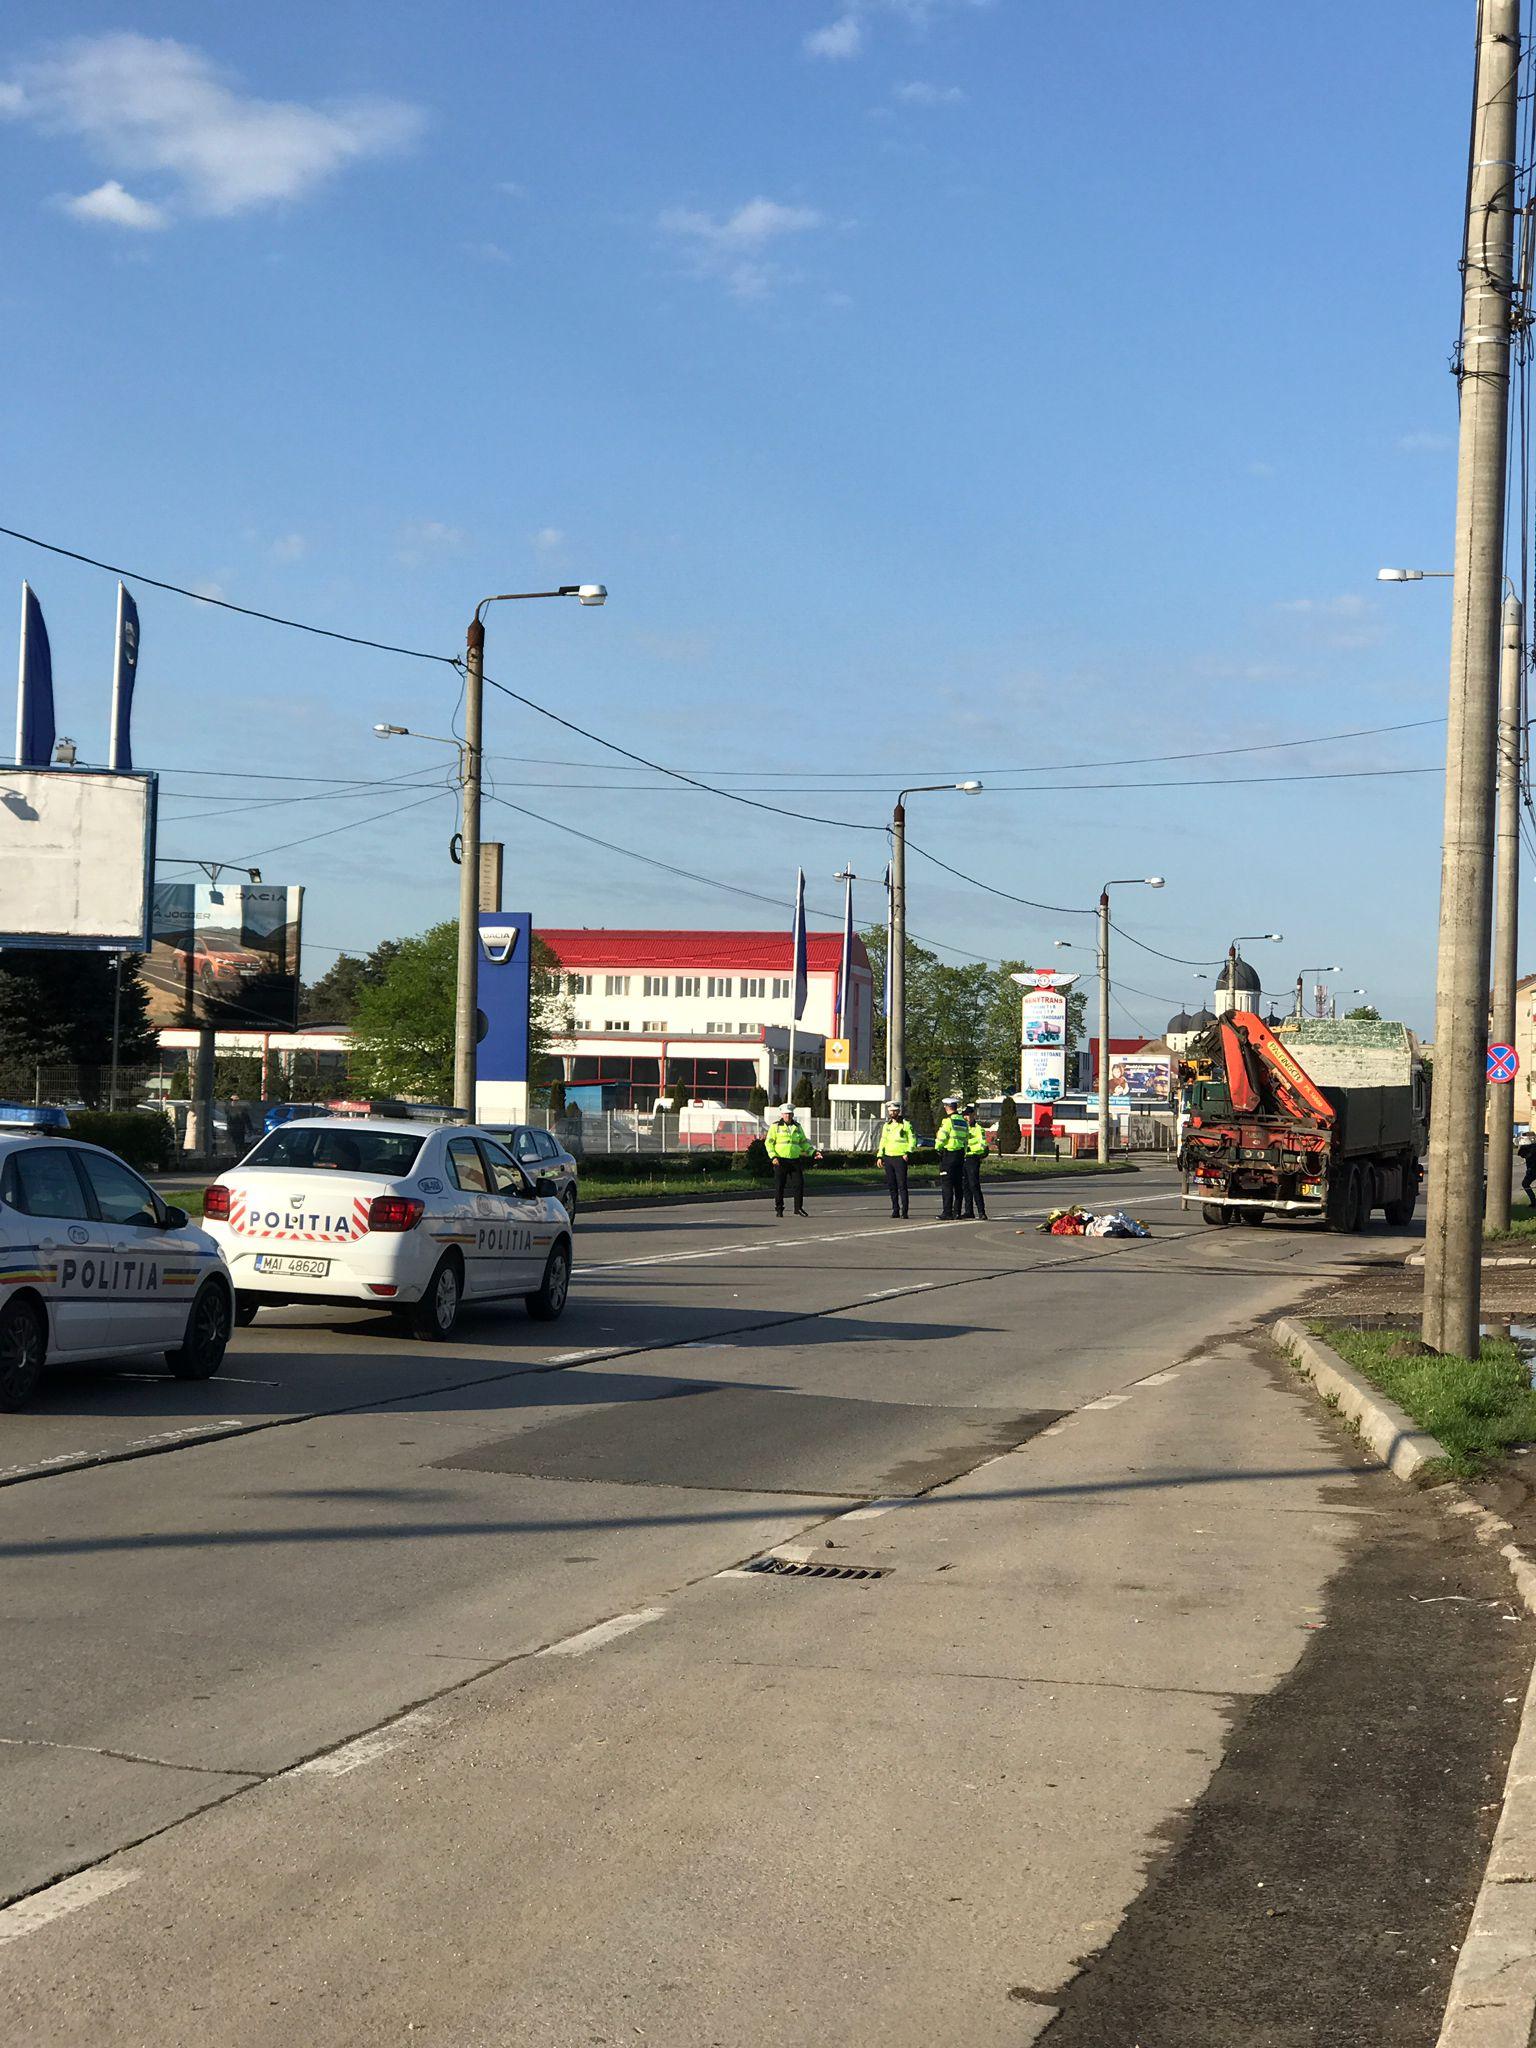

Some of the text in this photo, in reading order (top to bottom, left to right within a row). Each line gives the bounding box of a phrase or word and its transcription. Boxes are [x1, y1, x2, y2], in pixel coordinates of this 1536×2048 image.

[235, 892, 287, 901] DACIA
[1269, 1042, 1301, 1081] PALFINGER
[249, 1211, 350, 1233] POLITIA
[478, 1229, 531, 1250] POLITIA
[61, 1259, 158, 1290] POLITIA
[263, 1257, 283, 1270] MAI
[288, 1259, 325, 1274] 48620
